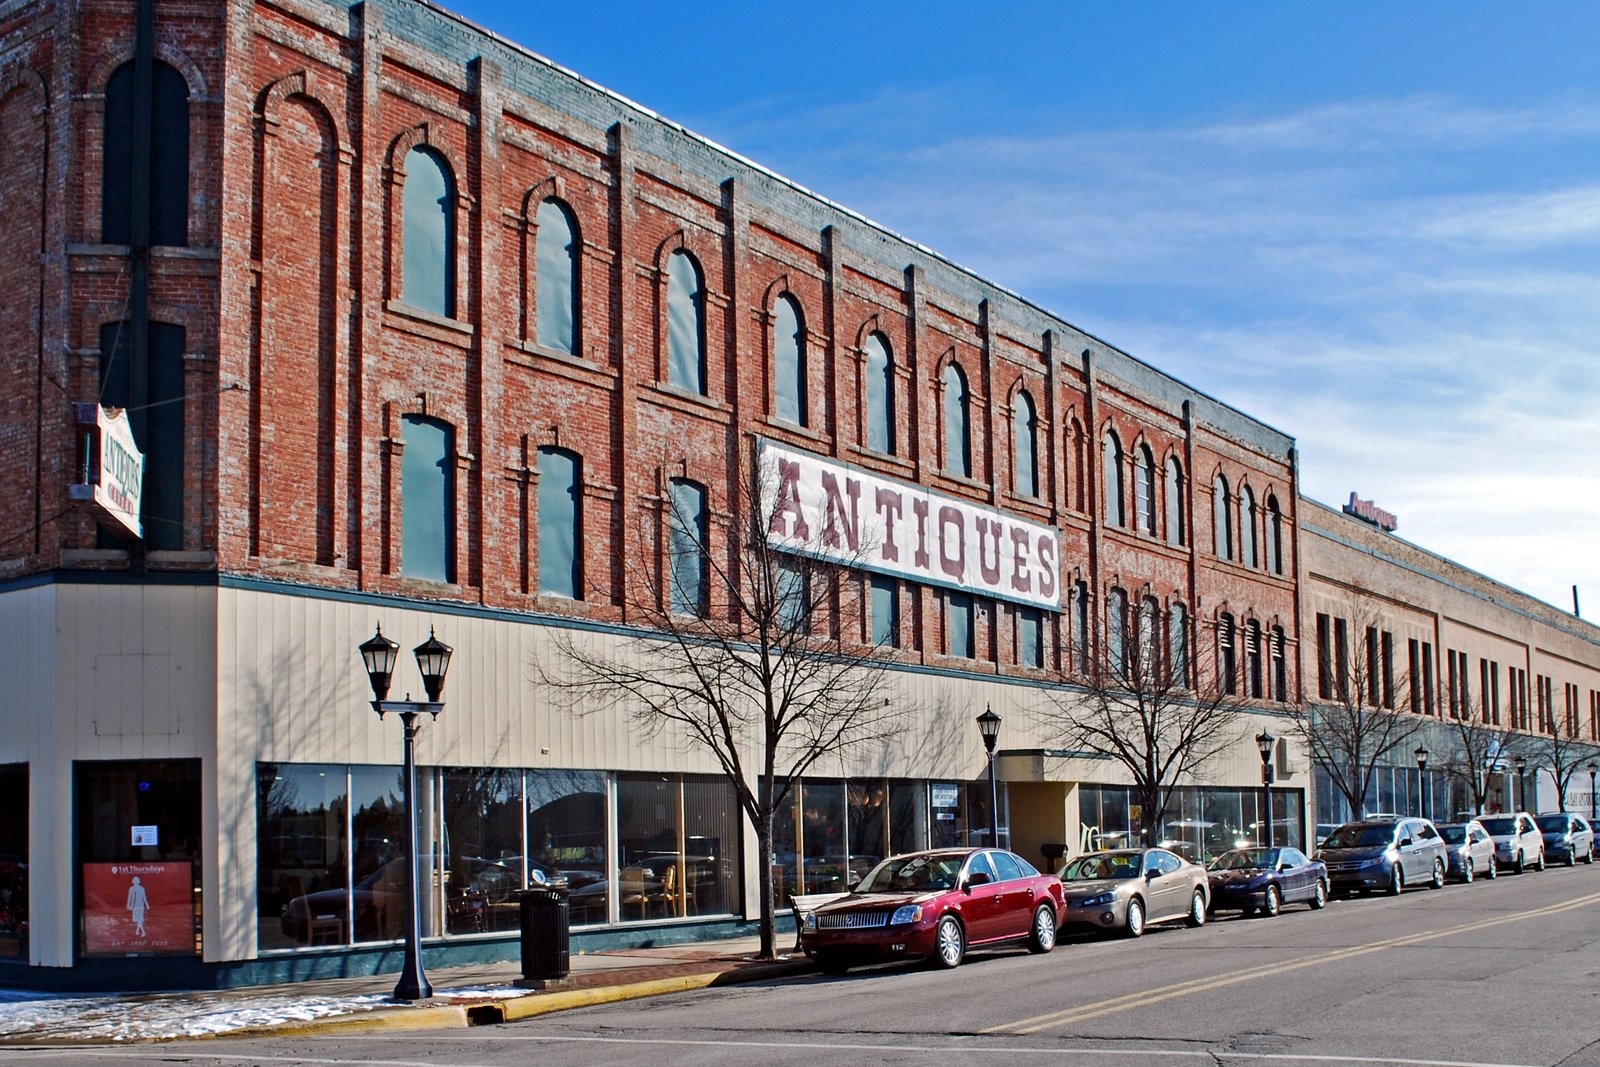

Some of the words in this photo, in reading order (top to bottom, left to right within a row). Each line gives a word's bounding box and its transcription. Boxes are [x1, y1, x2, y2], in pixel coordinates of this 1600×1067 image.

[103, 431, 140, 501] ANTIQUES
[769, 456, 1055, 599] ANTIQUES
[130, 865, 165, 874] Thursdays
